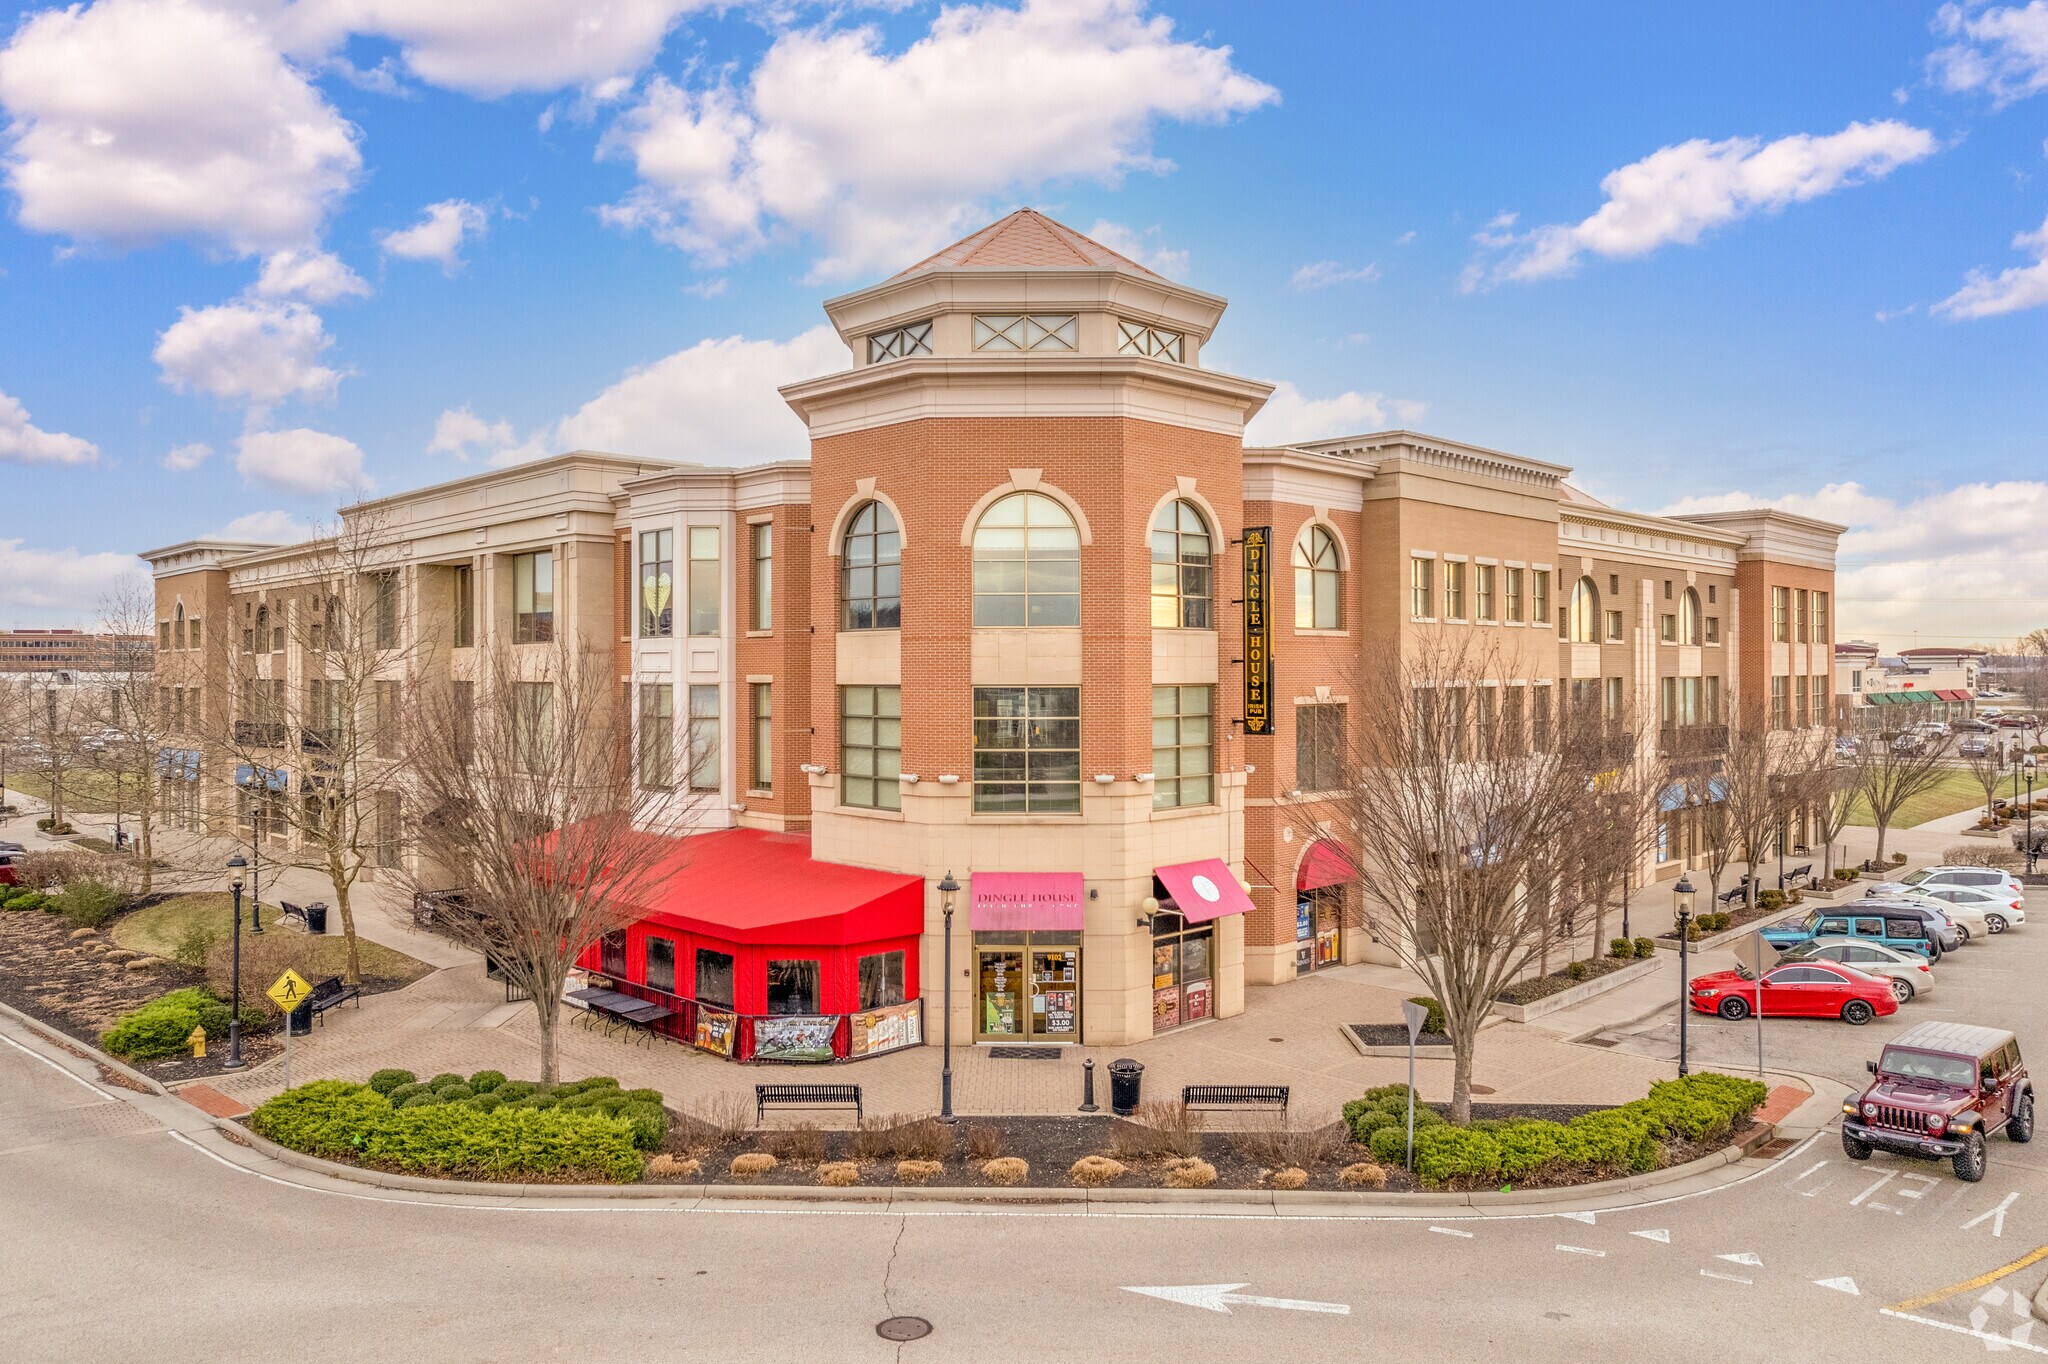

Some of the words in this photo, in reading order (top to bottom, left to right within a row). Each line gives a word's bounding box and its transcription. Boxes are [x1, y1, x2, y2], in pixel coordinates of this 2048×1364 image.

[1249, 549, 1261, 625] DINGLE
[1250, 636, 1262, 701] HOUSE
[978, 893, 1028, 903] DINGLE
[1032, 893, 1078, 902] HOUSE
